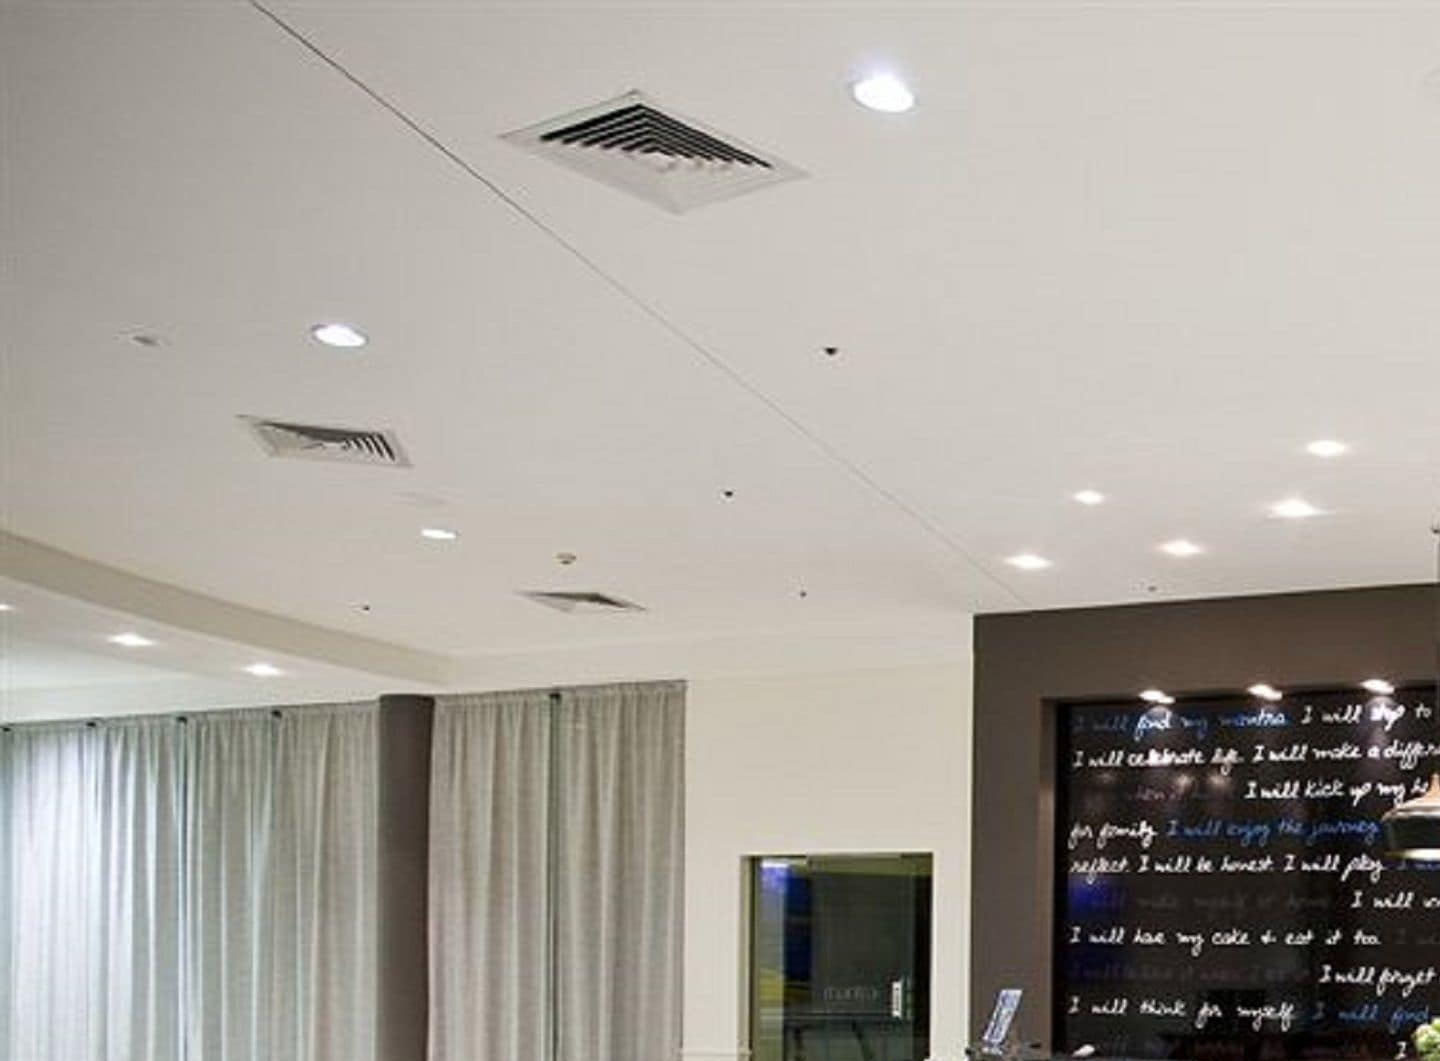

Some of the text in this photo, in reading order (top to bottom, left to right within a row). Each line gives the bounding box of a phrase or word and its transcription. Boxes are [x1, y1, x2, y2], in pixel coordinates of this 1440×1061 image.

[1300, 704, 1313, 725] I
[1320, 702, 1363, 725] will
[1414, 701, 1432, 719] to
[1070, 749, 1085, 769] I
[1087, 749, 1125, 768] will
[1126, 746, 1207, 768] celebrate
[1251, 744, 1266, 764] I
[1268, 742, 1308, 762] will
[1311, 741, 1362, 761] make
[1366, 743, 1382, 760] a
[1242, 779, 1259, 801] I
[1260, 779, 1301, 800] will
[1348, 782, 1373, 808] up
[1376, 781, 1407, 808] my
[1066, 821, 1094, 850] for
[1096, 819, 1160, 849] family
[1166, 819, 1180, 837] I
[1180, 819, 1223, 839] will
[1225, 821, 1271, 848] enjoy
[1277, 818, 1304, 838] the
[1136, 853, 1151, 873] I
[1154, 854, 1193, 873] will
[1195, 855, 1214, 873] be
[1283, 853, 1297, 873] I
[1300, 853, 1341, 873] will
[1349, 889, 1363, 909] I
[1372, 890, 1417, 909] will
[1068, 924, 1082, 945] I
[1087, 924, 1126, 945] will
[1131, 927, 1168, 946] have
[1175, 929, 1205, 958] my
[1210, 926, 1251, 946] cake
[1284, 926, 1316, 946] eat
[1325, 928, 1344, 946] it
[1318, 962, 1333, 984] I
[1335, 965, 1375, 985] will
[1375, 964, 1436, 998] forget
[1068, 995, 1081, 1015] I
[1090, 997, 1129, 1016] will
[1138, 997, 1188, 1017] think
[1193, 1001, 1223, 1030] for
[1235, 1001, 1296, 1033] myself
[1311, 1002, 1325, 1021] I
[1335, 1003, 1382, 1021] will
